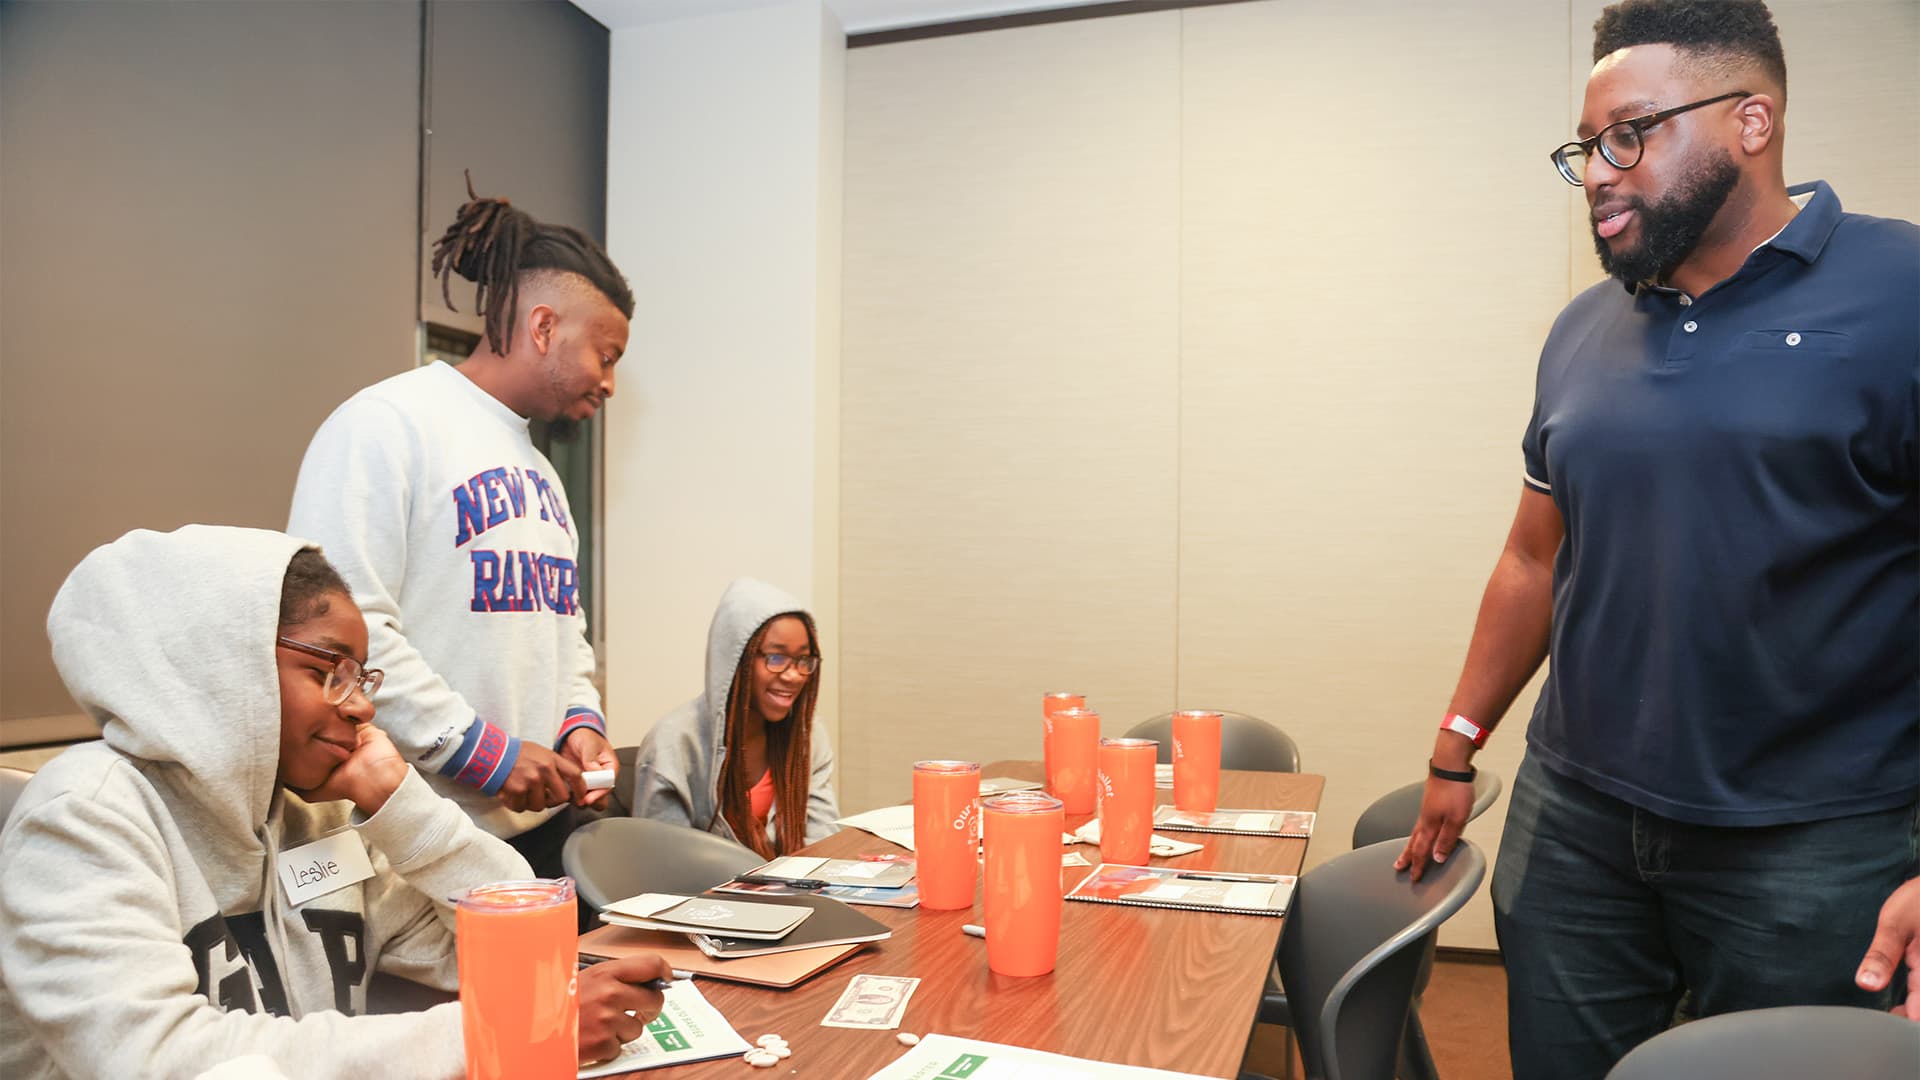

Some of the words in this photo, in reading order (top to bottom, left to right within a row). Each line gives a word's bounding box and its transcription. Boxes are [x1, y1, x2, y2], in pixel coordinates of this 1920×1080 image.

[452, 466, 526, 549] NEW
[953, 804, 971, 830] Our
[289, 860, 340, 889] Leslie
